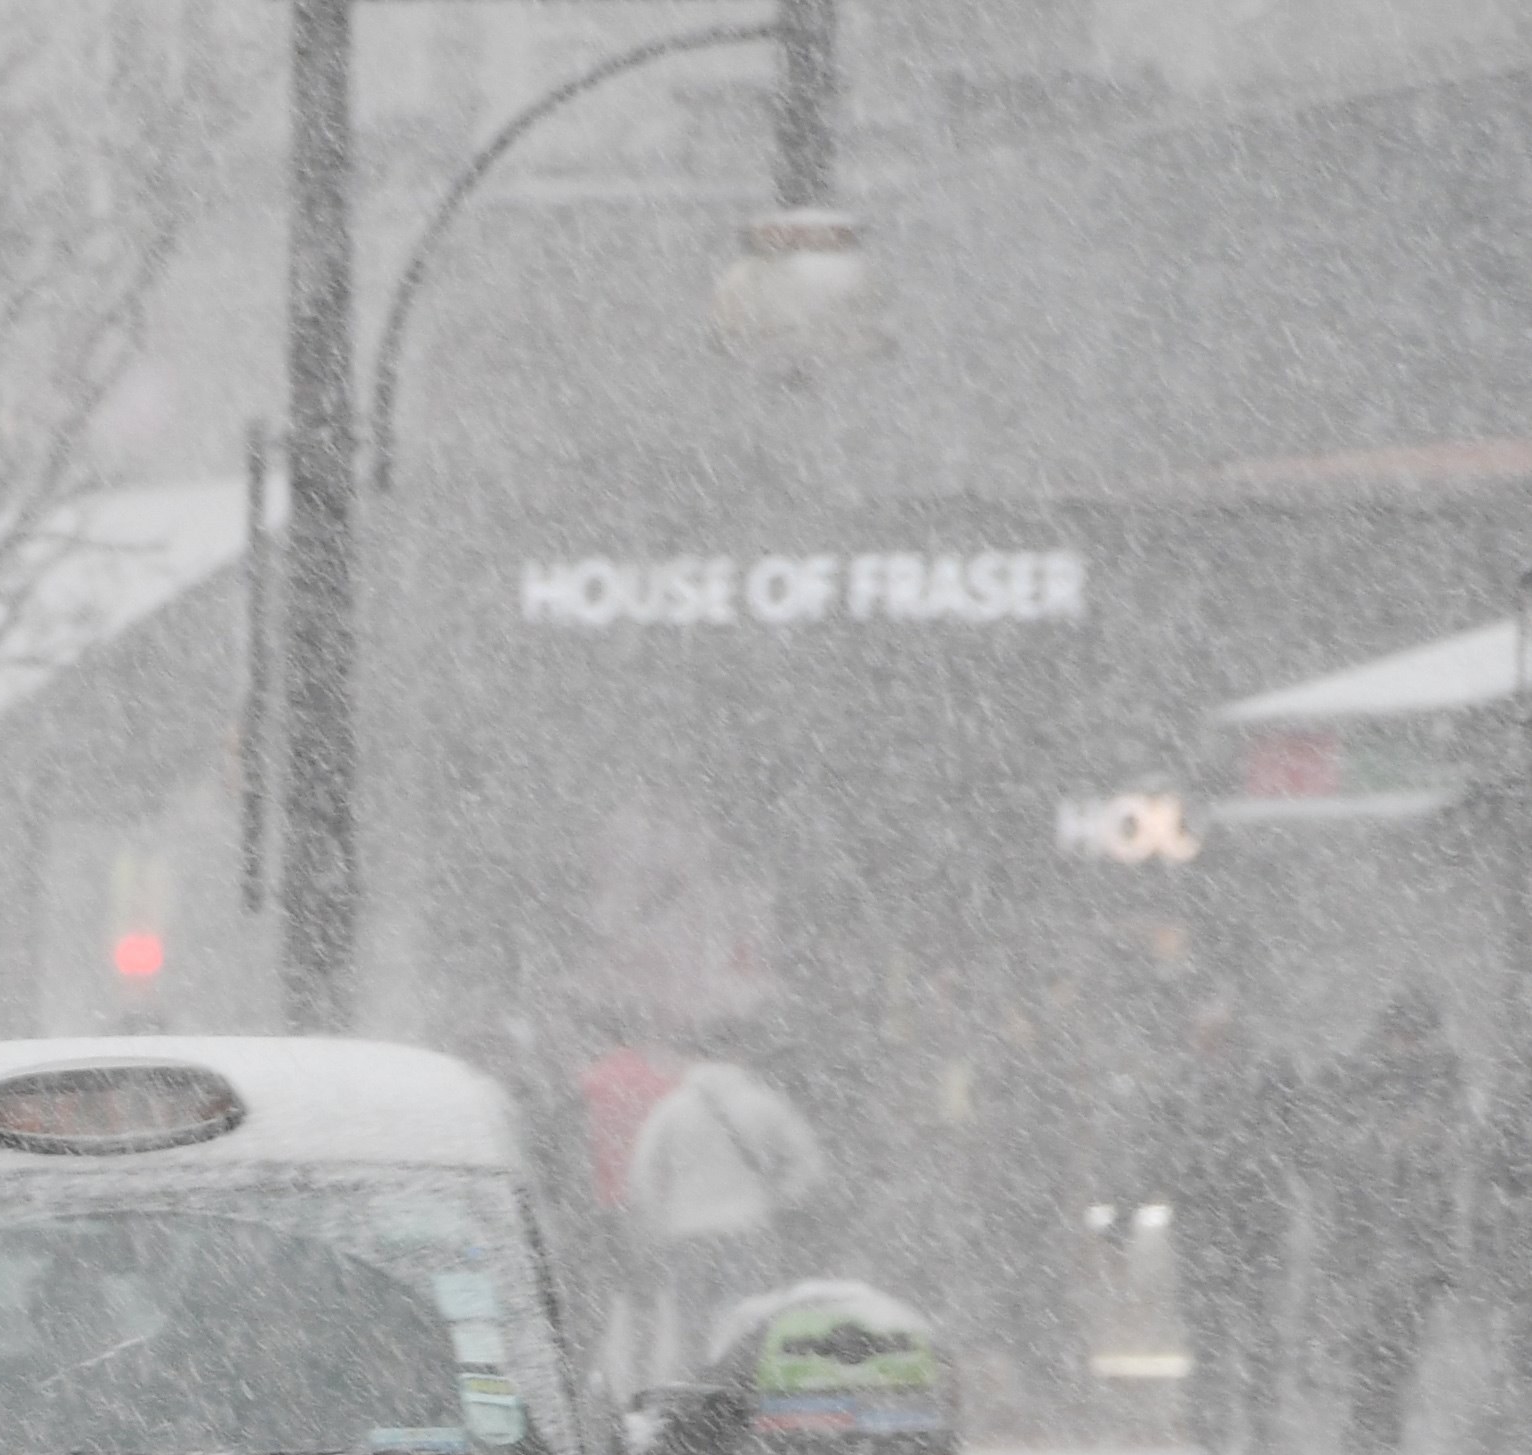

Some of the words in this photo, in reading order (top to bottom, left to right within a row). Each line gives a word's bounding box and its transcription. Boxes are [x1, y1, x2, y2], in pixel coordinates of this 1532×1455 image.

[521, 556, 735, 625] HOUSE
[747, 553, 836, 622] OF
[848, 550, 1085, 620] FRASER
